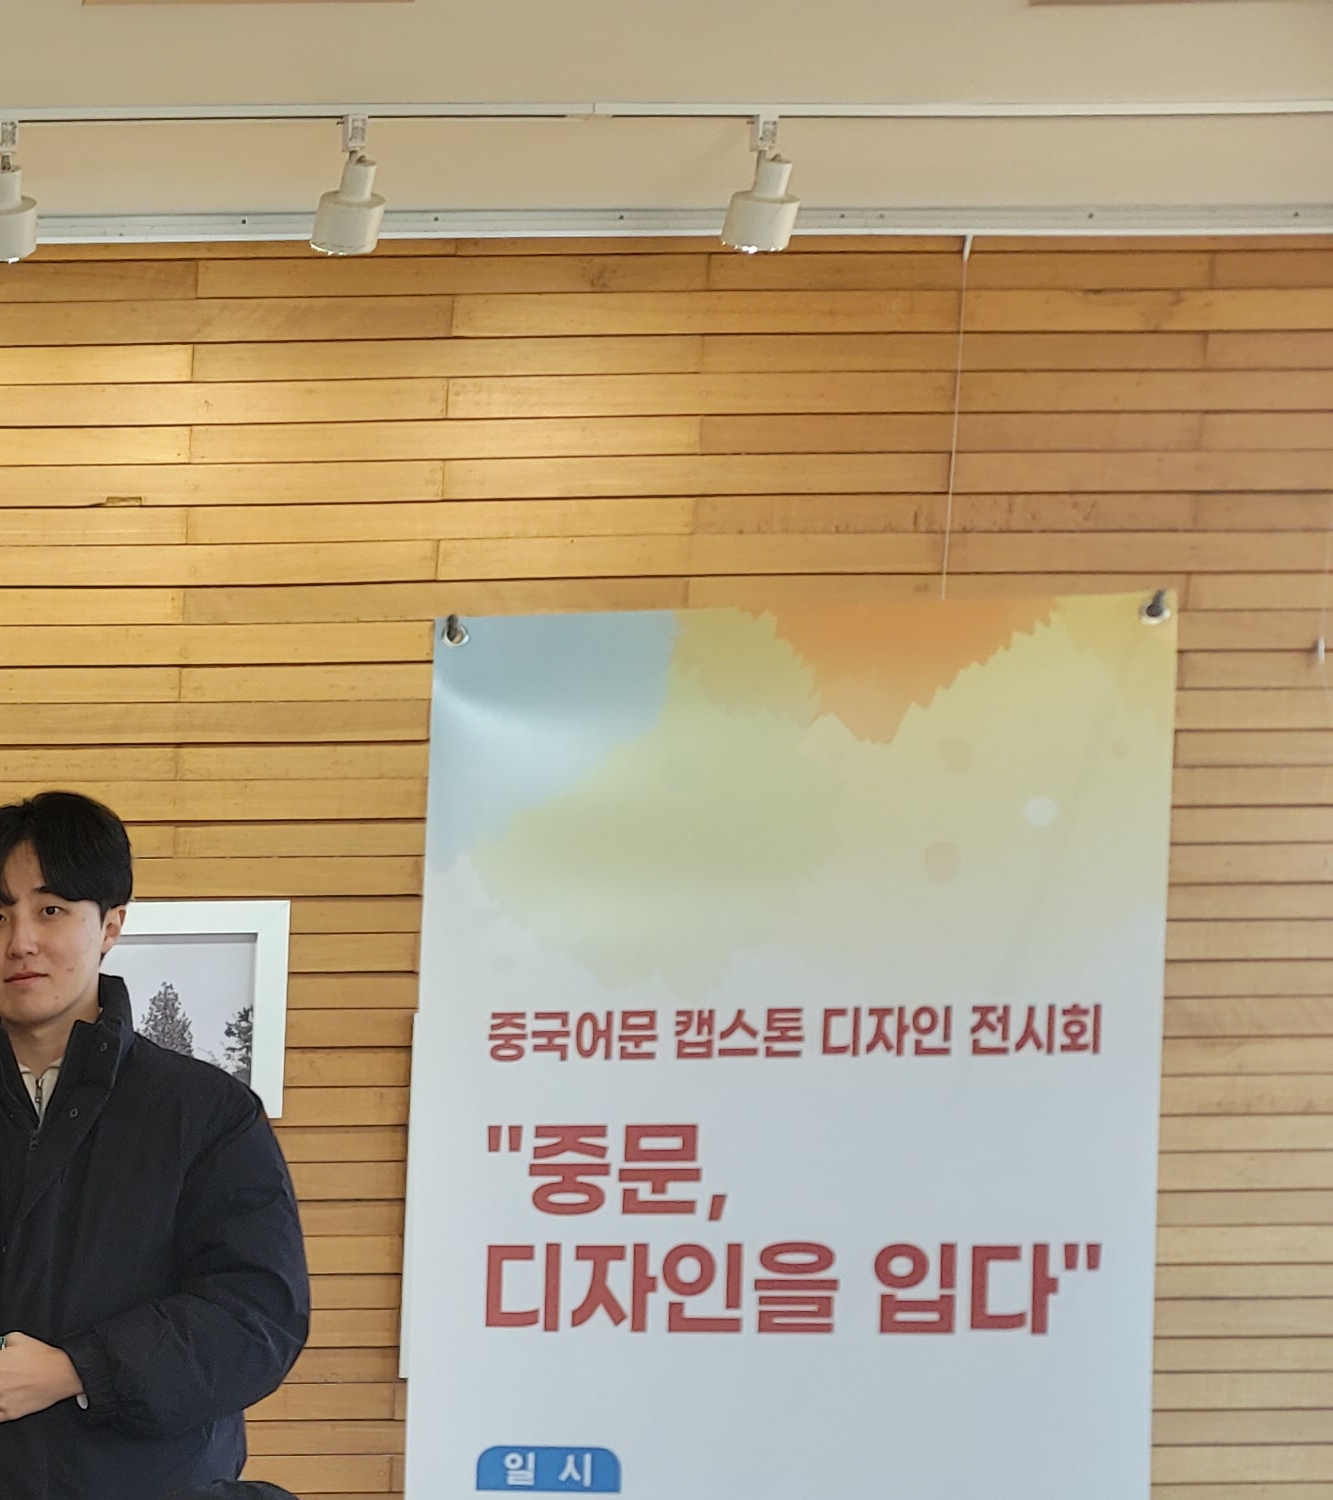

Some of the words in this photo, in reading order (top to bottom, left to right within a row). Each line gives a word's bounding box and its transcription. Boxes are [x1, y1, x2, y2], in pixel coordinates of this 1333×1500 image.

[489, 1010, 658, 1062] 중국어문
[675, 1008, 804, 1059] 캡스톤
[822, 1006, 952, 1057] 디자인
[970, 1004, 1101, 1055] 전시회
[488, 1124, 727, 1221] "중문,
[486, 1242, 839, 1333] 디자인을
[874, 1243, 1101, 1335] 입다"
[505, 1453, 534, 1485] 일
[560, 1454, 591, 1486] 시
